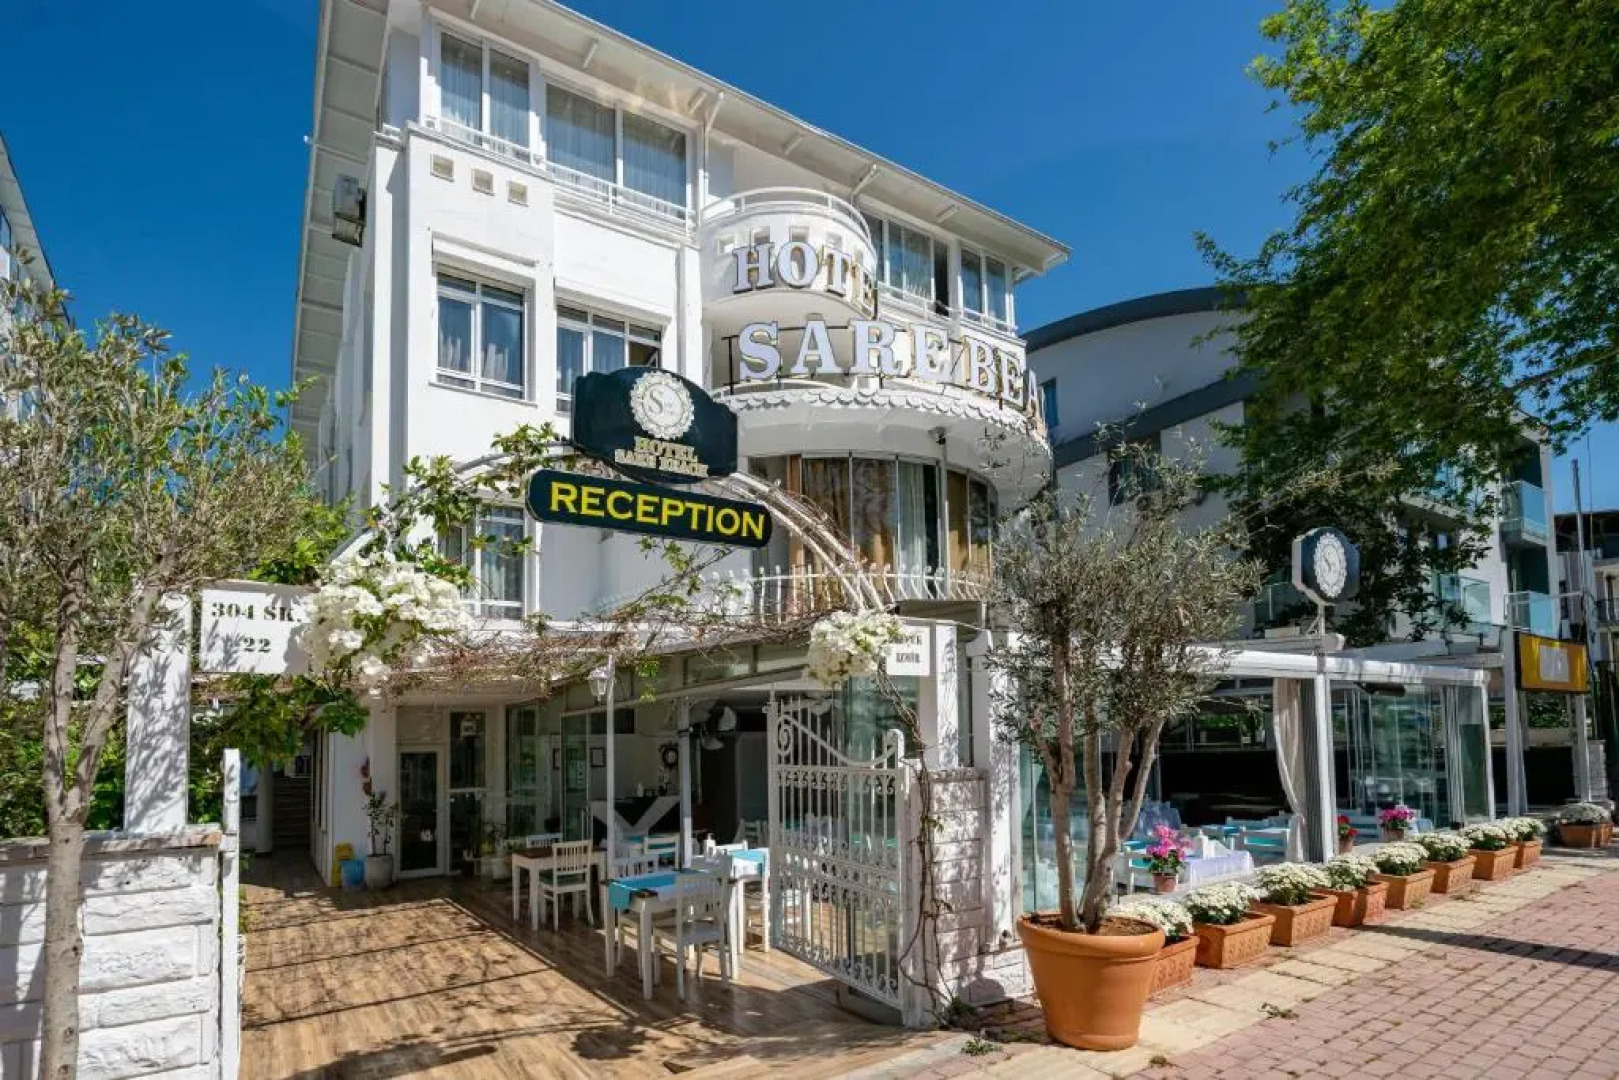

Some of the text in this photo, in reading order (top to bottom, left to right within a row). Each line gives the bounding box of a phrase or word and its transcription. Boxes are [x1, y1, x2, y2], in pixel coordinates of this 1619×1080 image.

[738, 313, 951, 383] SARE
[550, 481, 766, 540] RECEPTION
[211, 602, 254, 620] 304
[243, 636, 271, 653] 22
